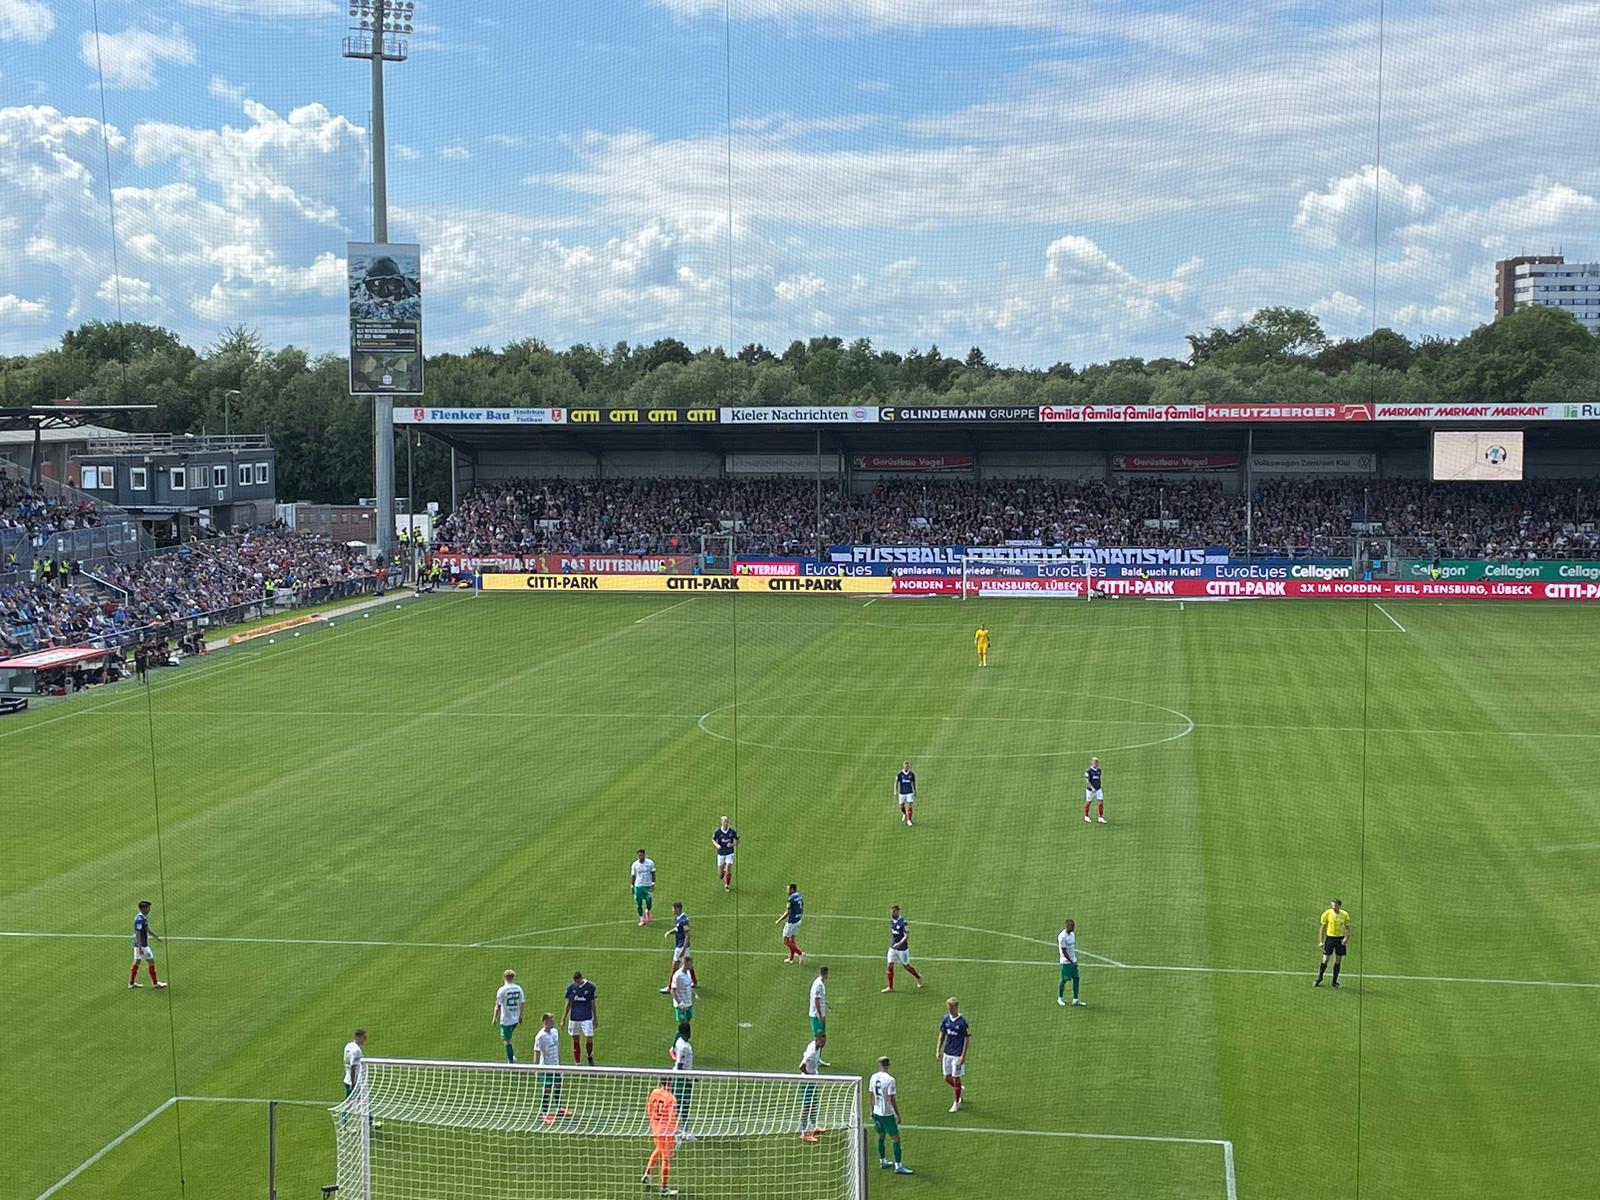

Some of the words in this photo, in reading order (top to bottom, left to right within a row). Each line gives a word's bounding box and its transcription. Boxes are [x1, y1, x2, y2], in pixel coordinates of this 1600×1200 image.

[431, 410, 482, 420] Flenker
[486, 410, 510, 420] Bau
[570, 409, 600, 422] CITTI
[609, 409, 639, 422] CITTI
[647, 409, 677, 422] CITTI
[686, 409, 716, 422] CITTI
[732, 409, 768, 421] Kieler
[771, 409, 848, 421] Nachrichten
[901, 409, 986, 419] GLINDEMANN
[989, 409, 1035, 419] GRUPPE
[1041, 406, 1080, 422] famila
[1082, 406, 1121, 422] famila
[1123, 406, 1162, 422] famila
[1164, 406, 1204, 422] famila
[1208, 407, 1336, 417] KREUTZBERGER
[1378, 407, 1434, 417] MARKANT
[1435, 407, 1491, 417] MARKANT
[1491, 407, 1549, 417] MARKANT
[918, 457, 945, 467] Vogel
[1181, 457, 1208, 467] Vogel
[853, 547, 961, 562] FUSSBALL
[1069, 548, 1204, 564] FANATISMUS
[997, 566, 1023, 576] rille.
[1121, 567, 1142, 576] Bald
[1169, 567, 1178, 576] in
[1181, 567, 1202, 576] Kiel!
[1215, 565, 1287, 580] EuroEyes
[1291, 565, 1350, 580] Cellagon
[1484, 565, 1540, 578] Cellagon
[1559, 565, 1600, 580] Cellag
[527, 576, 599, 589] CITTI-PARK
[667, 577, 740, 590] CITTI-PARK
[768, 577, 843, 591] CITTI-PARK
[900, 580, 944, 590] NORDEN
[981, 581, 1042, 592] FLENSBURG,
[1045, 579, 1083, 591] LÜBECK
[1096, 580, 1175, 595] CITTI-PARK
[1205, 581, 1286, 595] CITTI-PARK
[1299, 584, 1314, 593] 3X
[1318, 584, 1331, 593] IM
[1334, 584, 1381, 594] NORDEN
[1394, 584, 1420, 595] KIEL,
[1423, 584, 1489, 596] FLENSBURG,
[1491, 583, 1533, 595] LÜBECK
